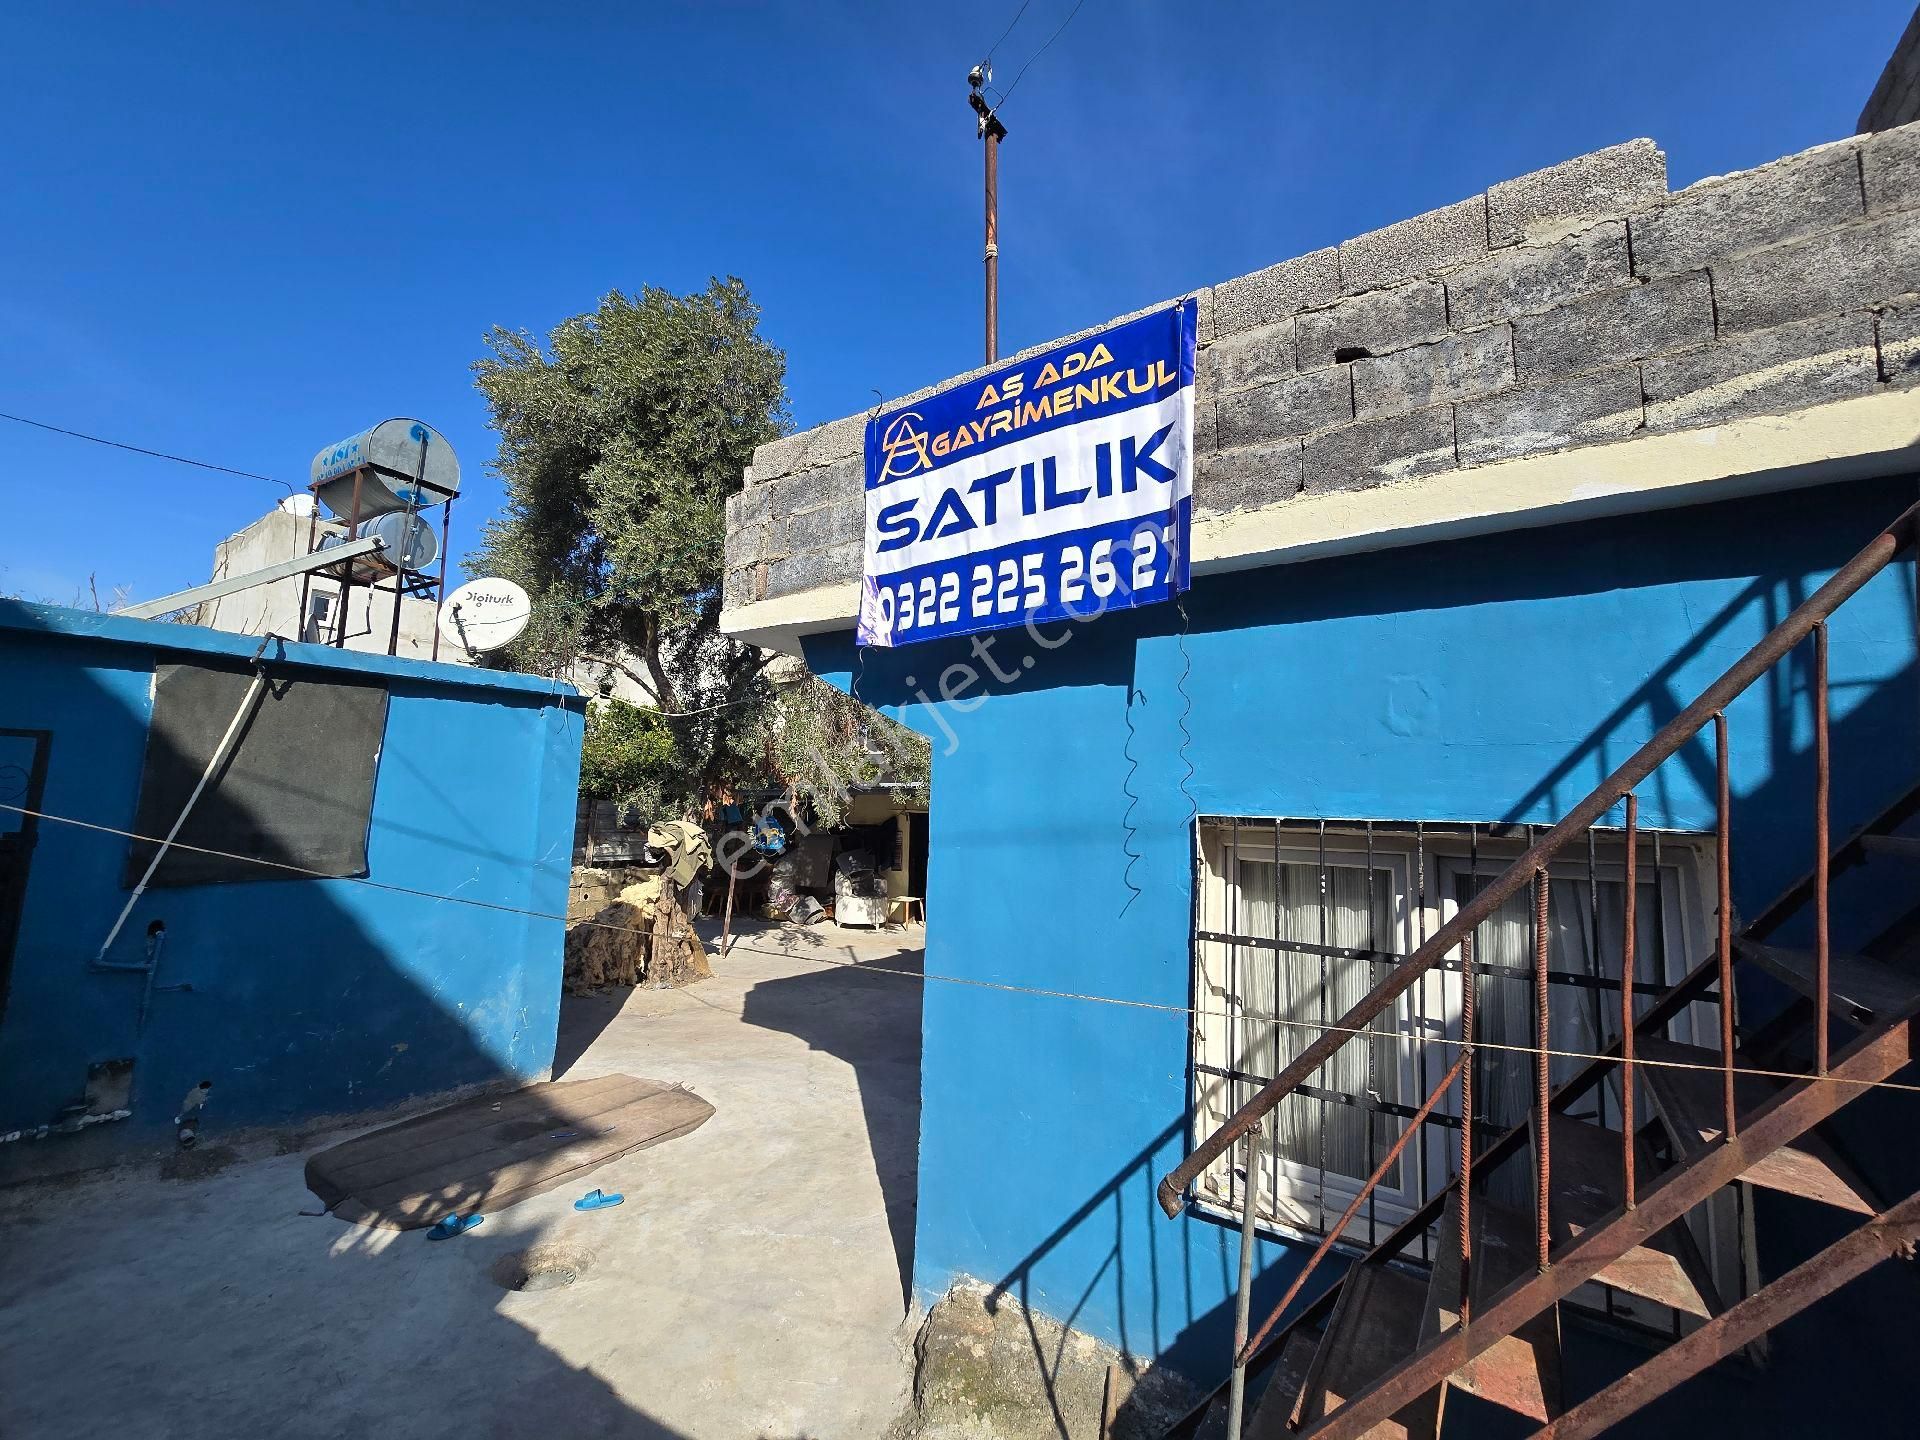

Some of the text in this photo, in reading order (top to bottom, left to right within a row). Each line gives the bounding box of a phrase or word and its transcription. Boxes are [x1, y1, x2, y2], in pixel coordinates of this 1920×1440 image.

[931, 359, 1177, 457] GAYRİMENKUL
[975, 343, 1115, 411] AS ADA
[876, 420, 1179, 554] SATILIK
[878, 571, 960, 636] 0322
[971, 552, 1046, 619] 225
[1060, 538, 1117, 603] 26
